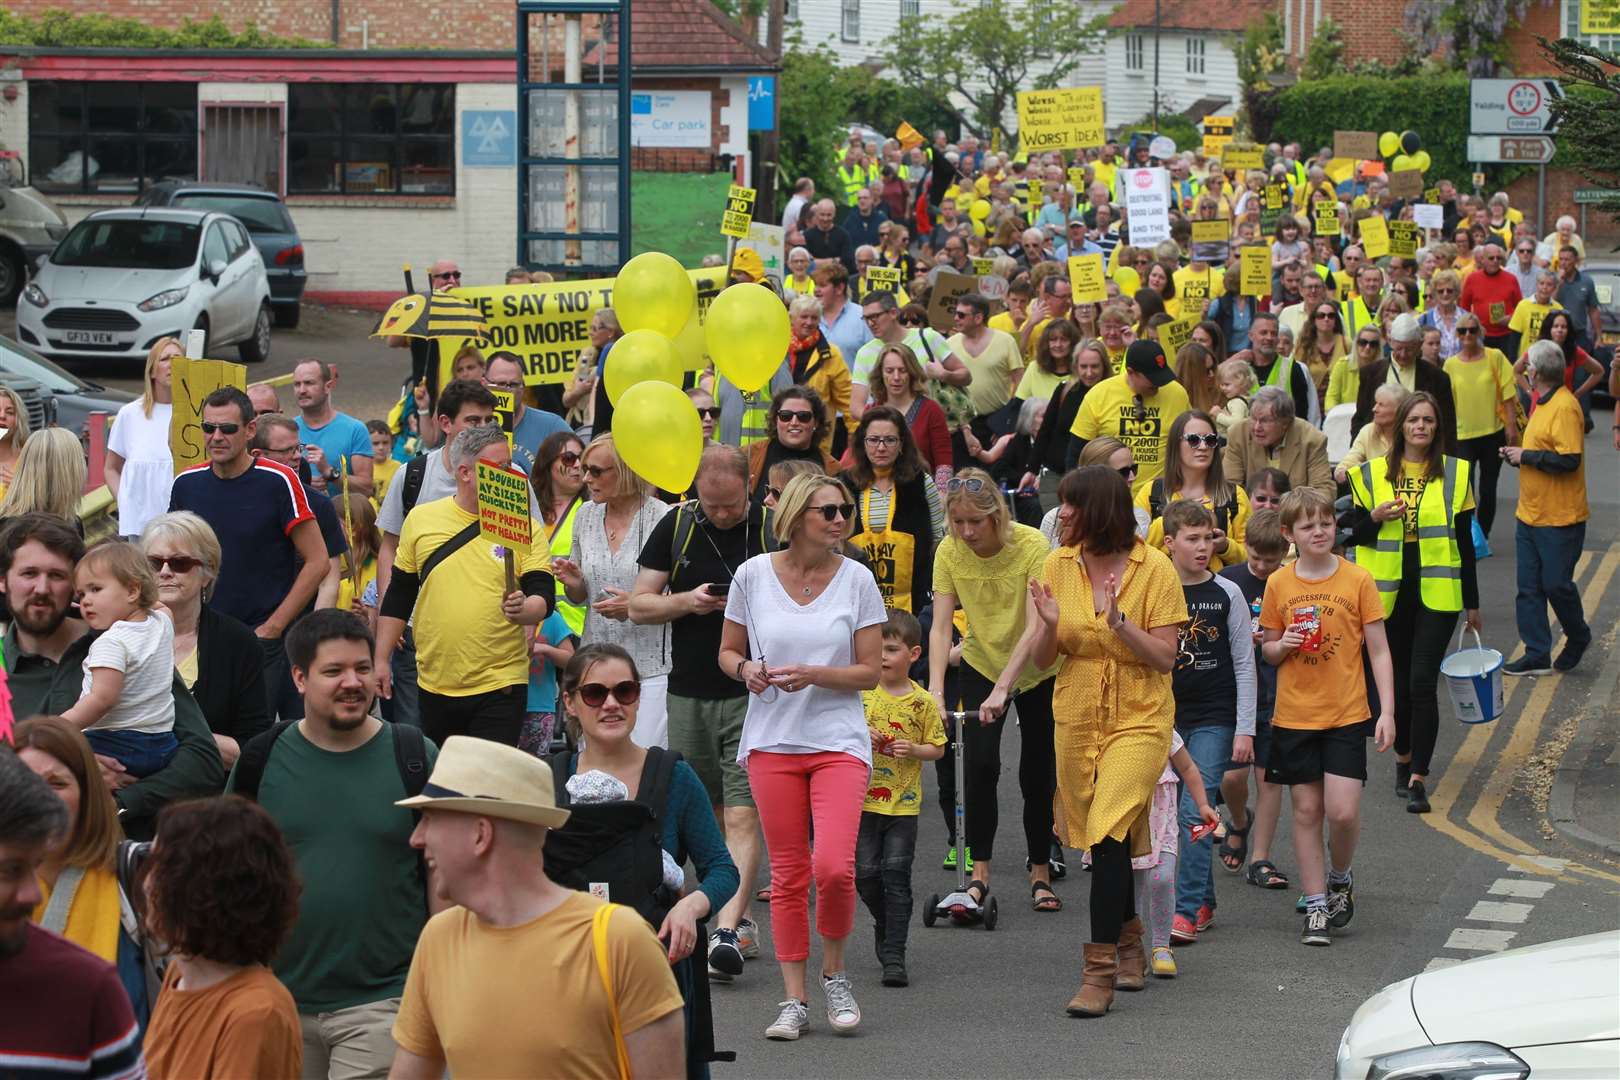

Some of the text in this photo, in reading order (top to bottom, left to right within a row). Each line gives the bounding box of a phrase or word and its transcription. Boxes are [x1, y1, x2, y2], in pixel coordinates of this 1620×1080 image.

[1474, 102, 1505, 111] Yalding
[652, 119, 705, 131] Car park
[1022, 129, 1070, 146] WORST
[730, 199, 747, 212] NO
[1319, 210, 1334, 218] NO
[1133, 224, 1164, 233] AND THE
[1394, 231, 1411, 240] NO
[883, 271, 897, 279] SAY
[873, 280, 892, 291] NO
[1186, 287, 1205, 297] NO
[503, 294, 546, 317] SAY
[66, 331, 90, 342] GF13
[523, 319, 589, 346] MORE
[1120, 406, 1136, 417] WE
[1125, 419, 1156, 436] NO
[1134, 437, 1159, 447] 2000
[489, 470, 526, 491] DOUBLED
[480, 482, 491, 494] MY
[493, 486, 516, 502] SIZE
[479, 493, 515, 513] QUICKLY
[481, 507, 528, 531] NOT PRETTY
[482, 520, 497, 534] NOT
[1288, 593, 1332, 606] SUCCESSFUL
[1304, 655, 1318, 666] NO
